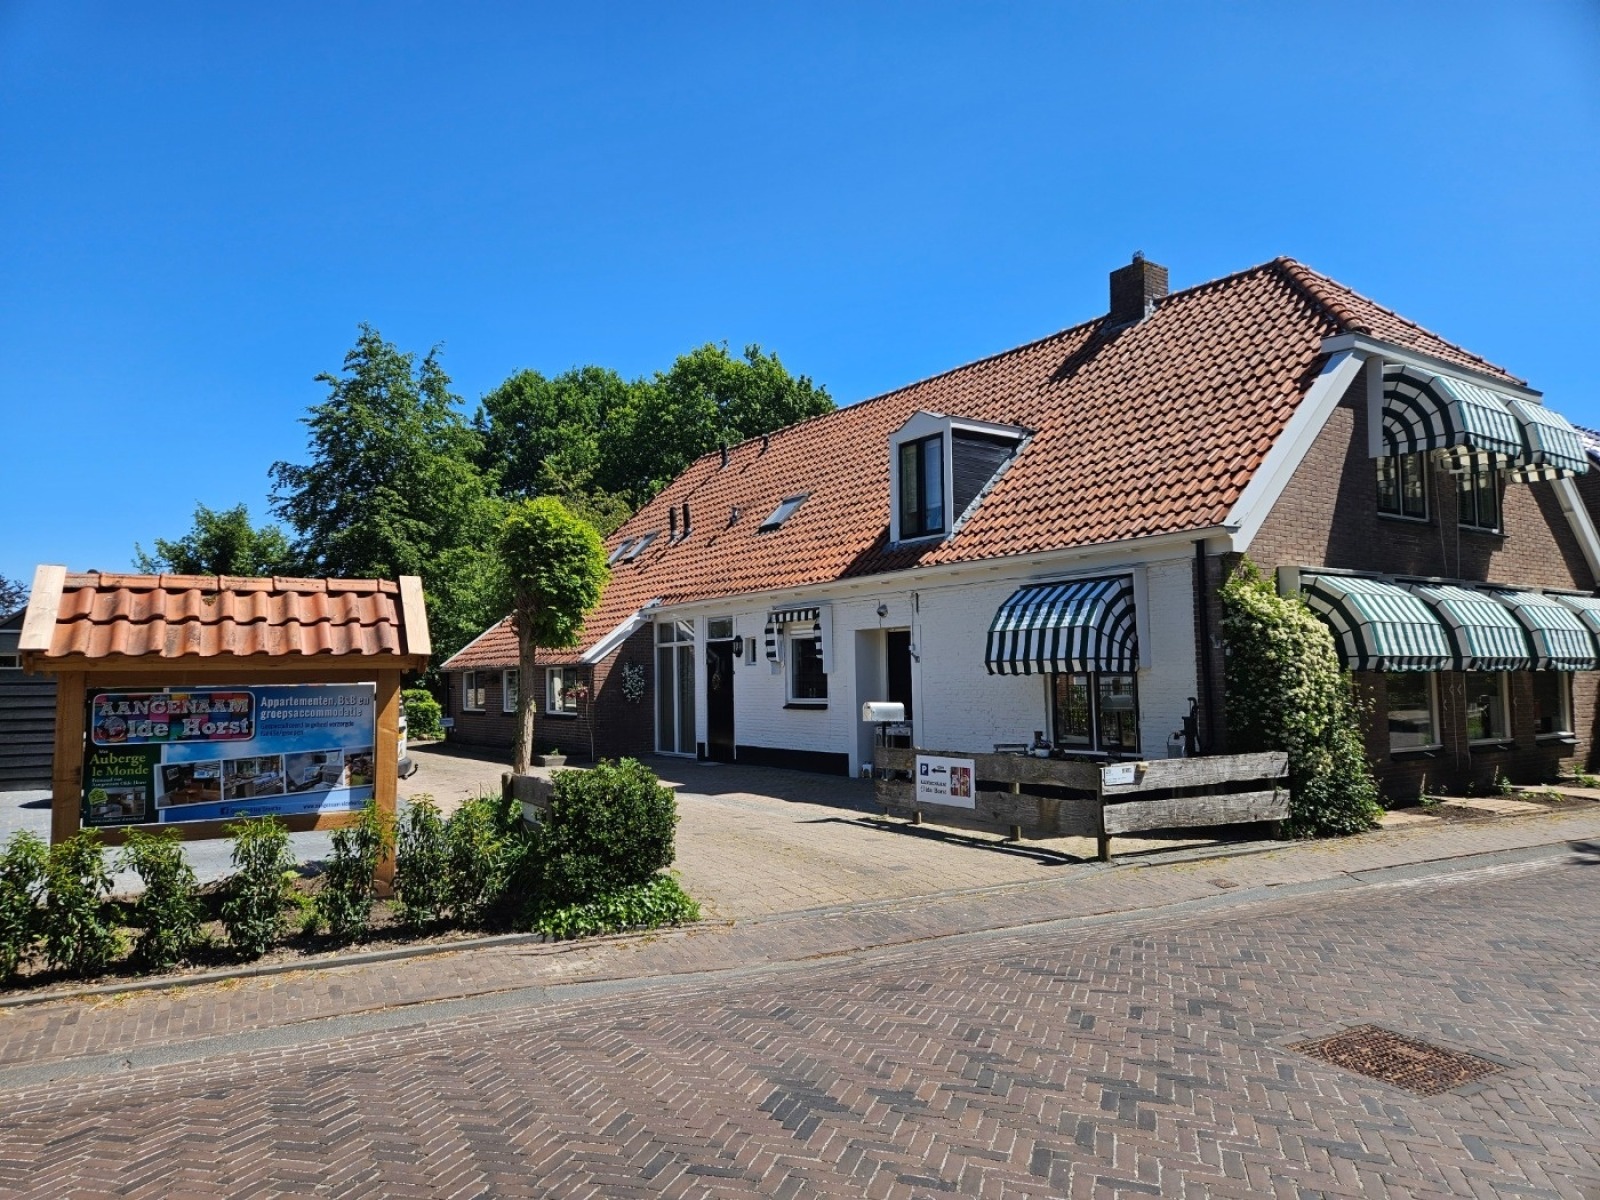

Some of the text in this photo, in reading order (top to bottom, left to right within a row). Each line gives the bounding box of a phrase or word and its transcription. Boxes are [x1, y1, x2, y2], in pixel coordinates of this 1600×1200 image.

[99, 698, 249, 715] AANGENAAM
[260, 696, 337, 708] Appartementen,
[358, 696, 370, 706] en
[260, 707, 363, 721] groepsaccommodatie
[181, 717, 249, 736] Horst
[89, 752, 146, 767] Auberge
[92, 764, 150, 777] le Monde
